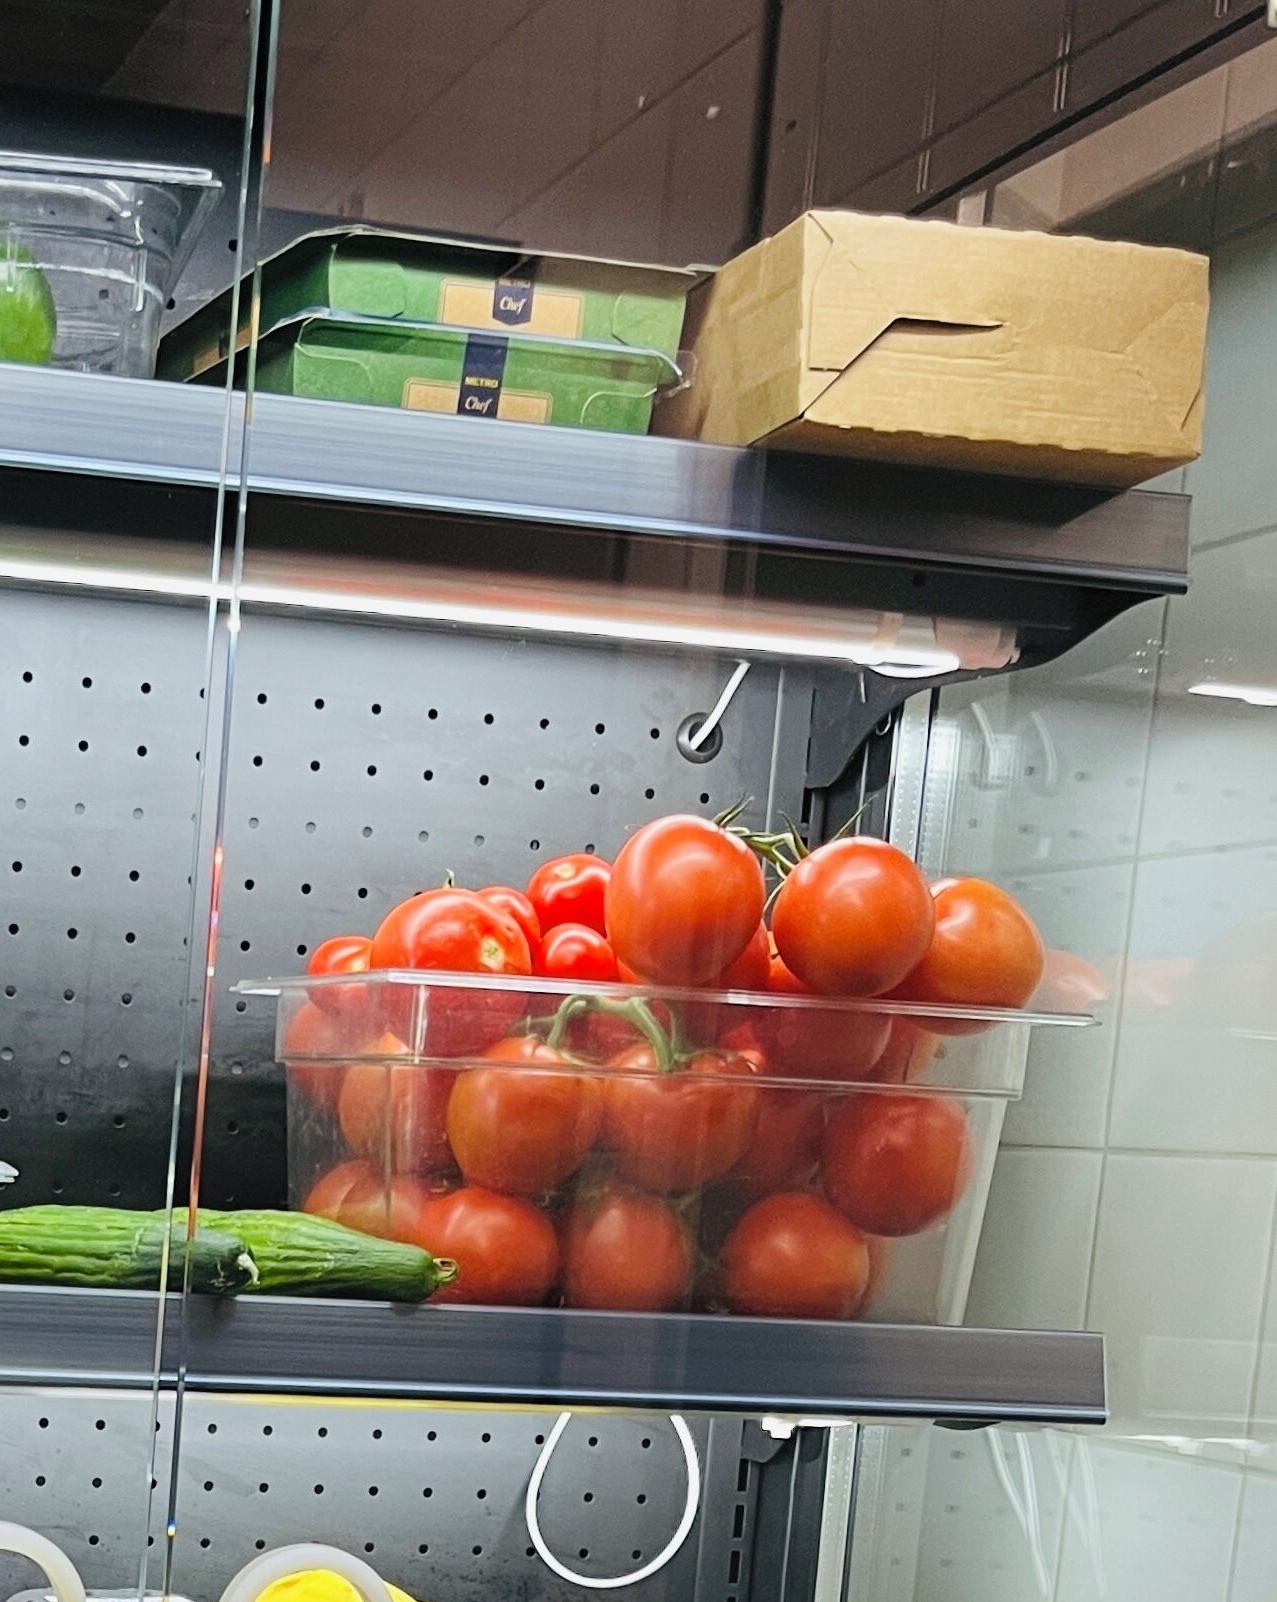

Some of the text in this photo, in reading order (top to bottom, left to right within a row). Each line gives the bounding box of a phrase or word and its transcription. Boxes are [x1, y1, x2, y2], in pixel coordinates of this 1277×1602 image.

[500, 297, 526, 315] Chef
[465, 376, 499, 388] METRO
[465, 396, 492, 415] Chef
